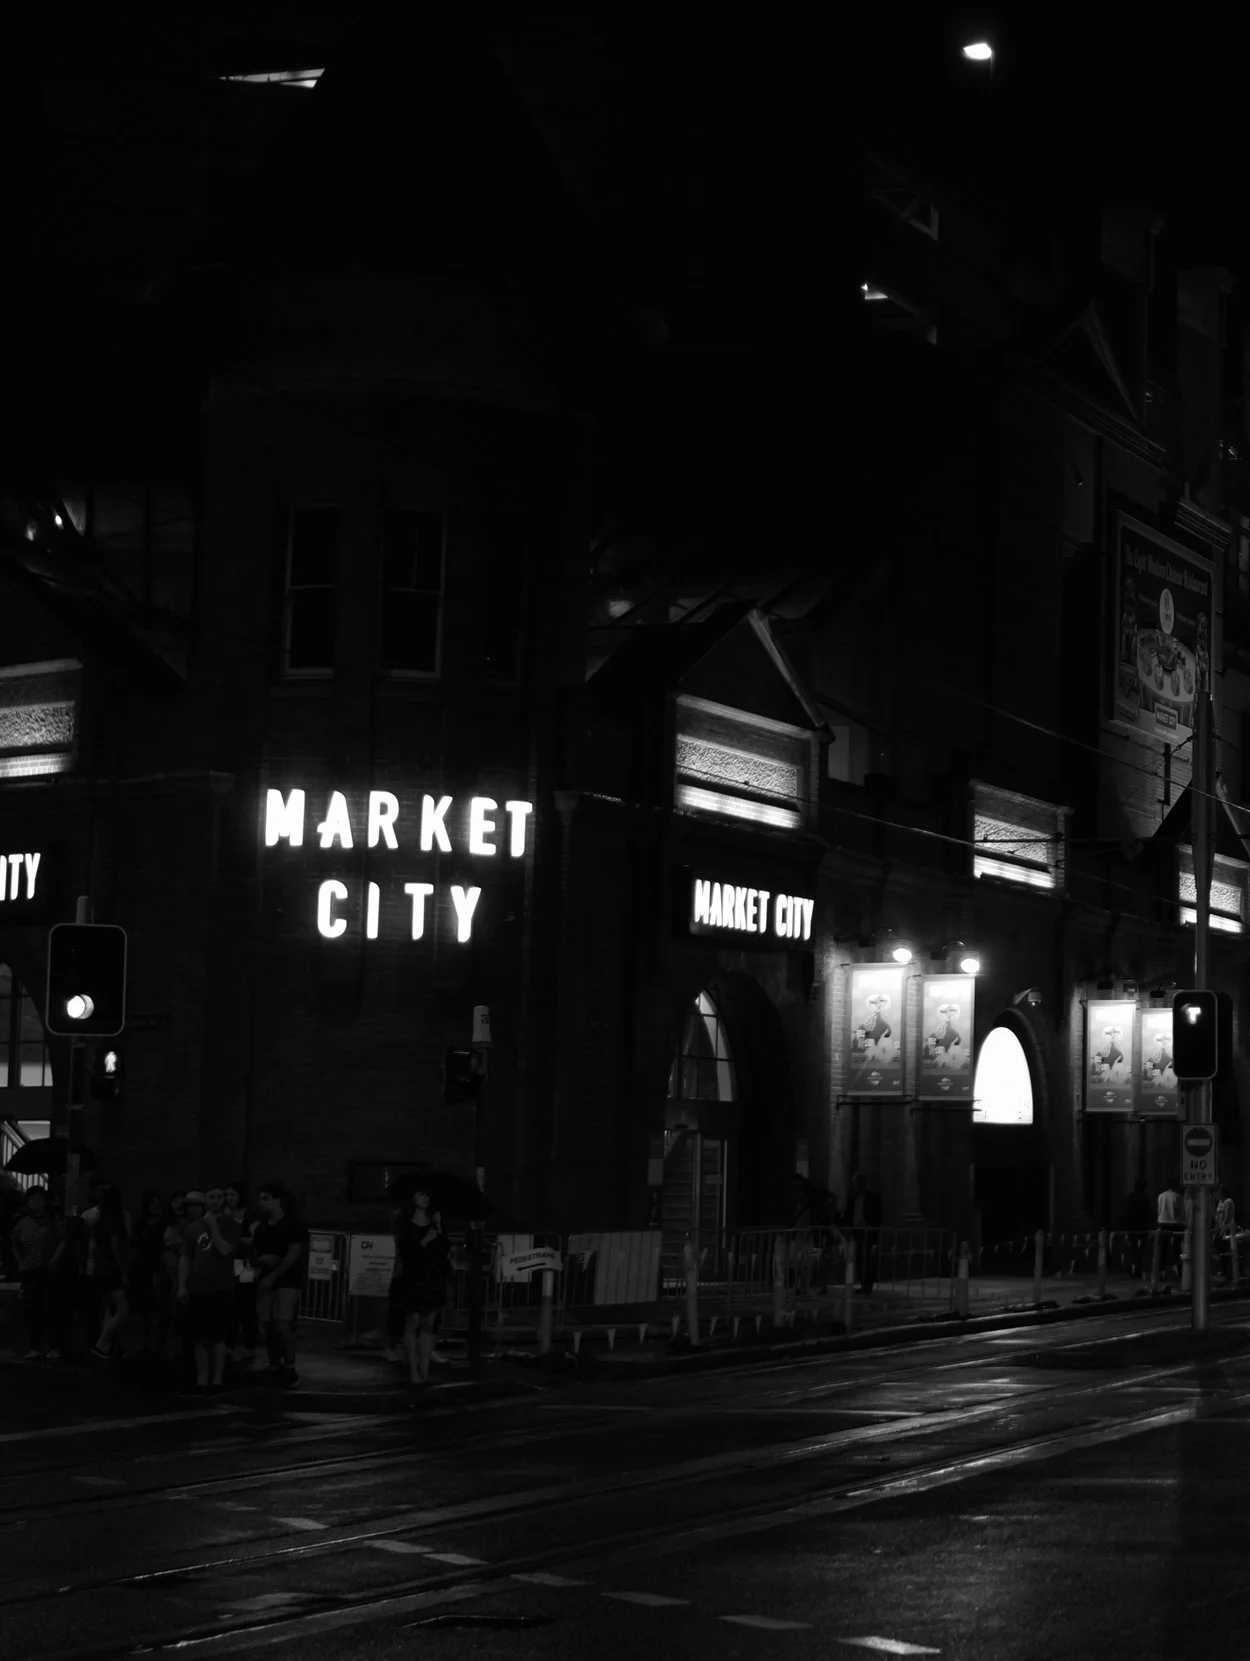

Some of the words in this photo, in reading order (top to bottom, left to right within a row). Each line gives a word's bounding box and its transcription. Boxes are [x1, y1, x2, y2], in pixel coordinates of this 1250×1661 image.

[265, 788, 533, 858] MARKET
[317, 879, 482, 943] CITY
[694, 878, 770, 934] MARKET
[775, 893, 815, 941] CITY
[1184, 1172, 1212, 1181] ENTRY
[1190, 1159, 1207, 1170] NO
